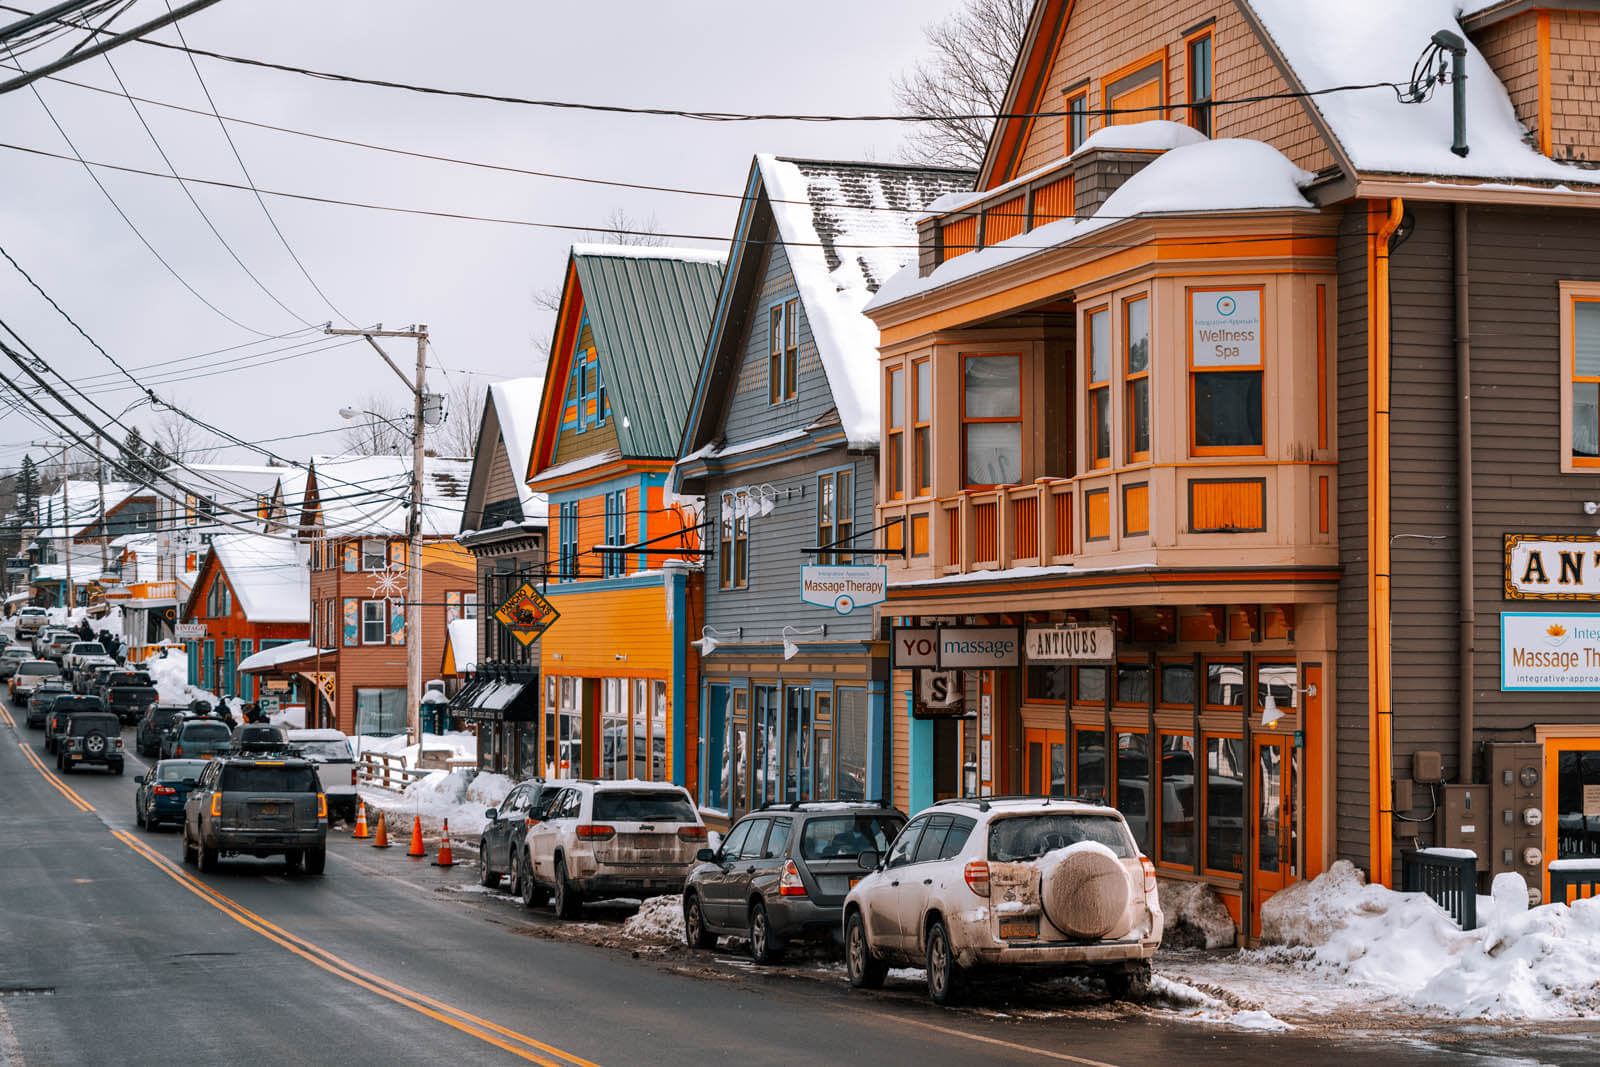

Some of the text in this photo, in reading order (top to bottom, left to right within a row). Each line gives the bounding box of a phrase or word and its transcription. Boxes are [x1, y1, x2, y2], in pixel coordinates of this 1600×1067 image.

[1199, 329, 1255, 342] Wellness
[1215, 345, 1240, 360] Spa
[1520, 550, 1600, 585] AN
[804, 580, 883, 594] Massage Therapy
[500, 589, 527, 615] PANCHO
[903, 638, 936, 656] YO
[944, 640, 1014, 659] massage
[1037, 630, 1097, 657] ANTIQUES
[1513, 648, 1579, 672] Massage
